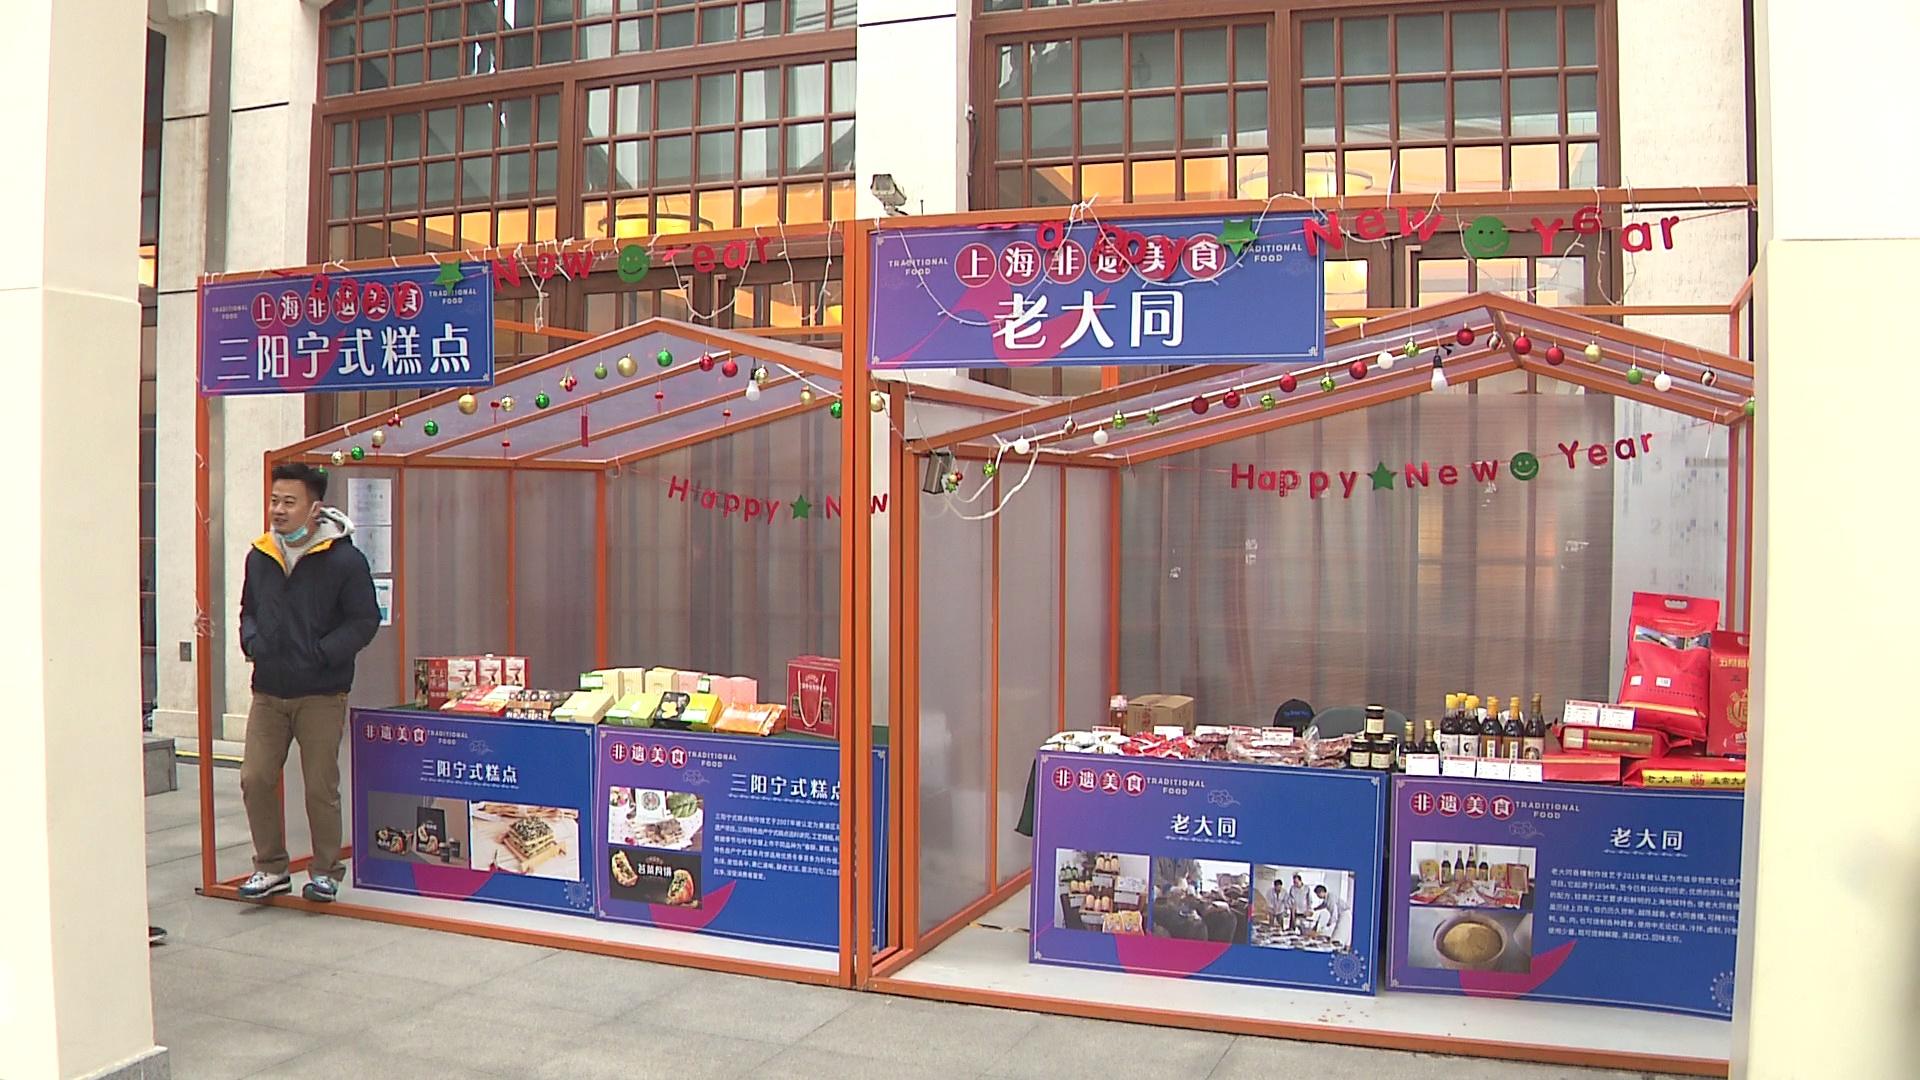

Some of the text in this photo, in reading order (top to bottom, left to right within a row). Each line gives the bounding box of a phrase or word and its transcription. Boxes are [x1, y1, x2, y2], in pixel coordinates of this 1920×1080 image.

[1303, 207, 1446, 256] New
[1241, 243, 1303, 254] ADITIONAL
[491, 248, 594, 290] New
[889, 258, 948, 268] TRADITIONAL
[905, 268, 931, 276] FOOD
[992, 289, 1184, 351] 老大同
[217, 323, 470, 381] 三阳宁式糕点
[1230, 431, 1654, 499] Happy New Year
[668, 475, 888, 524] Happy Nw
[366, 723, 425, 744] 非遗美食
[427, 729, 469, 739] TRADITIONAL
[612, 743, 685, 765] 非遗美食
[688, 751, 737, 761] TRADITIONAL
[421, 759, 517, 784] 三阳宁式糕点
[1055, 768, 1142, 792] 非遗美食
[1147, 777, 1205, 788] TRADITIONAL
[1162, 787, 1188, 795] FOOD
[1414, 793, 1510, 816] 非遗美食
[1516, 801, 1580, 812] TRADITIONAL
[1533, 811, 1561, 819] FOOD
[1170, 813, 1237, 838] 老大同
[1610, 827, 1684, 851] 老大同
